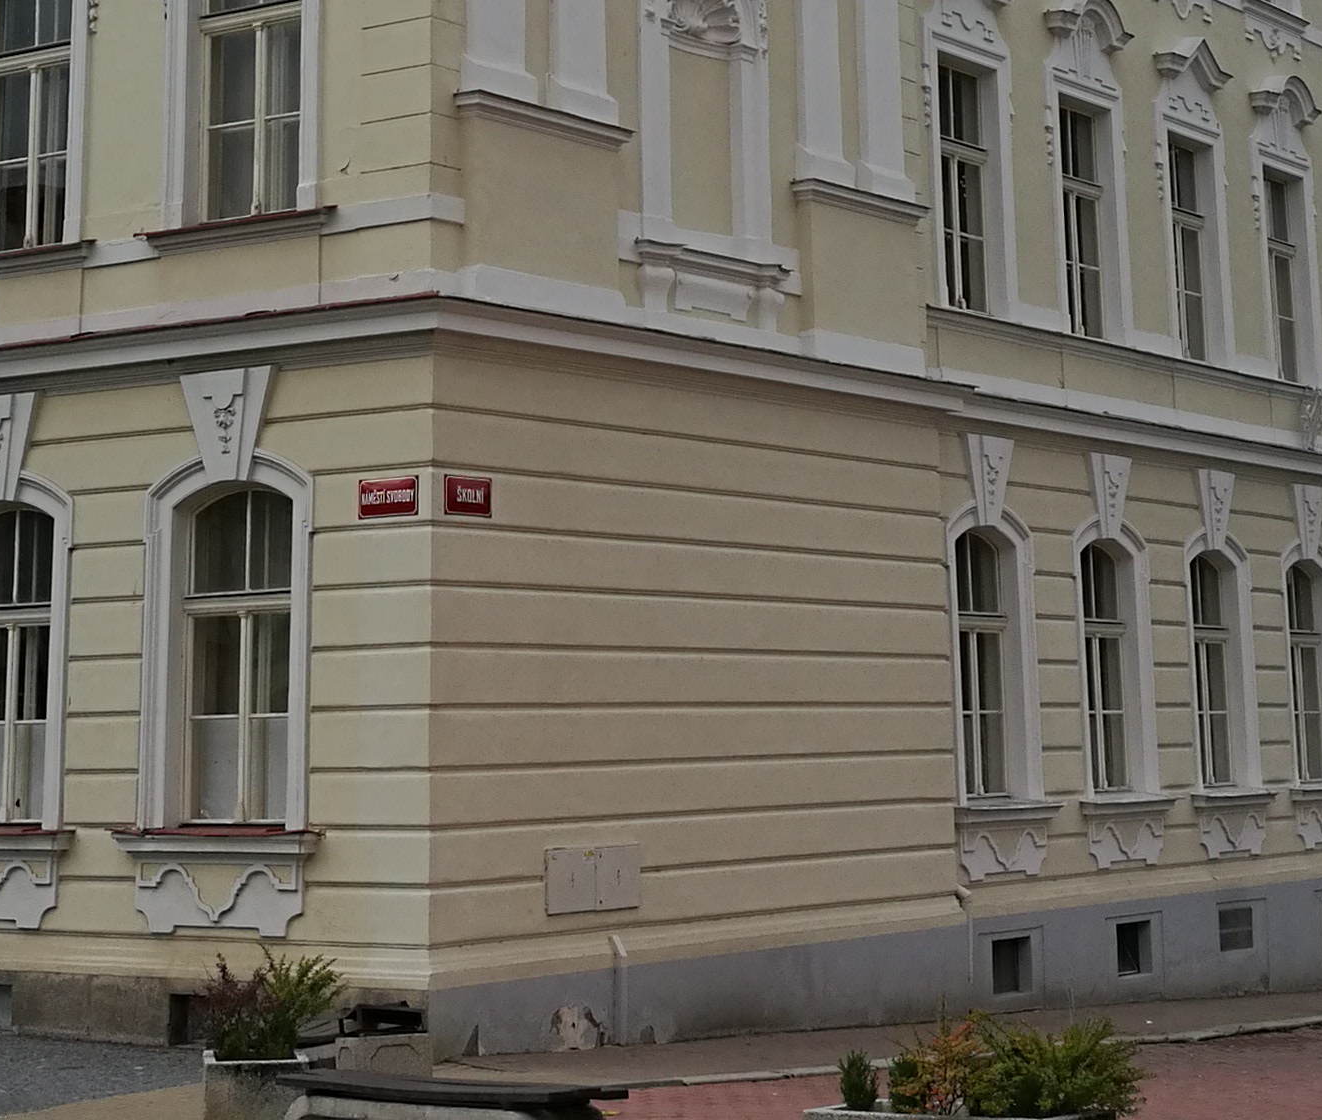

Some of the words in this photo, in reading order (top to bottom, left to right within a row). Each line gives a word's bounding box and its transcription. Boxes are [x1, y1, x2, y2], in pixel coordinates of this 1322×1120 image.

[361, 488, 386, 505] NÁMĚSTÍ
[386, 488, 415, 504] SVOBODY
[457, 485, 484, 504] ŠKOLNÍ
